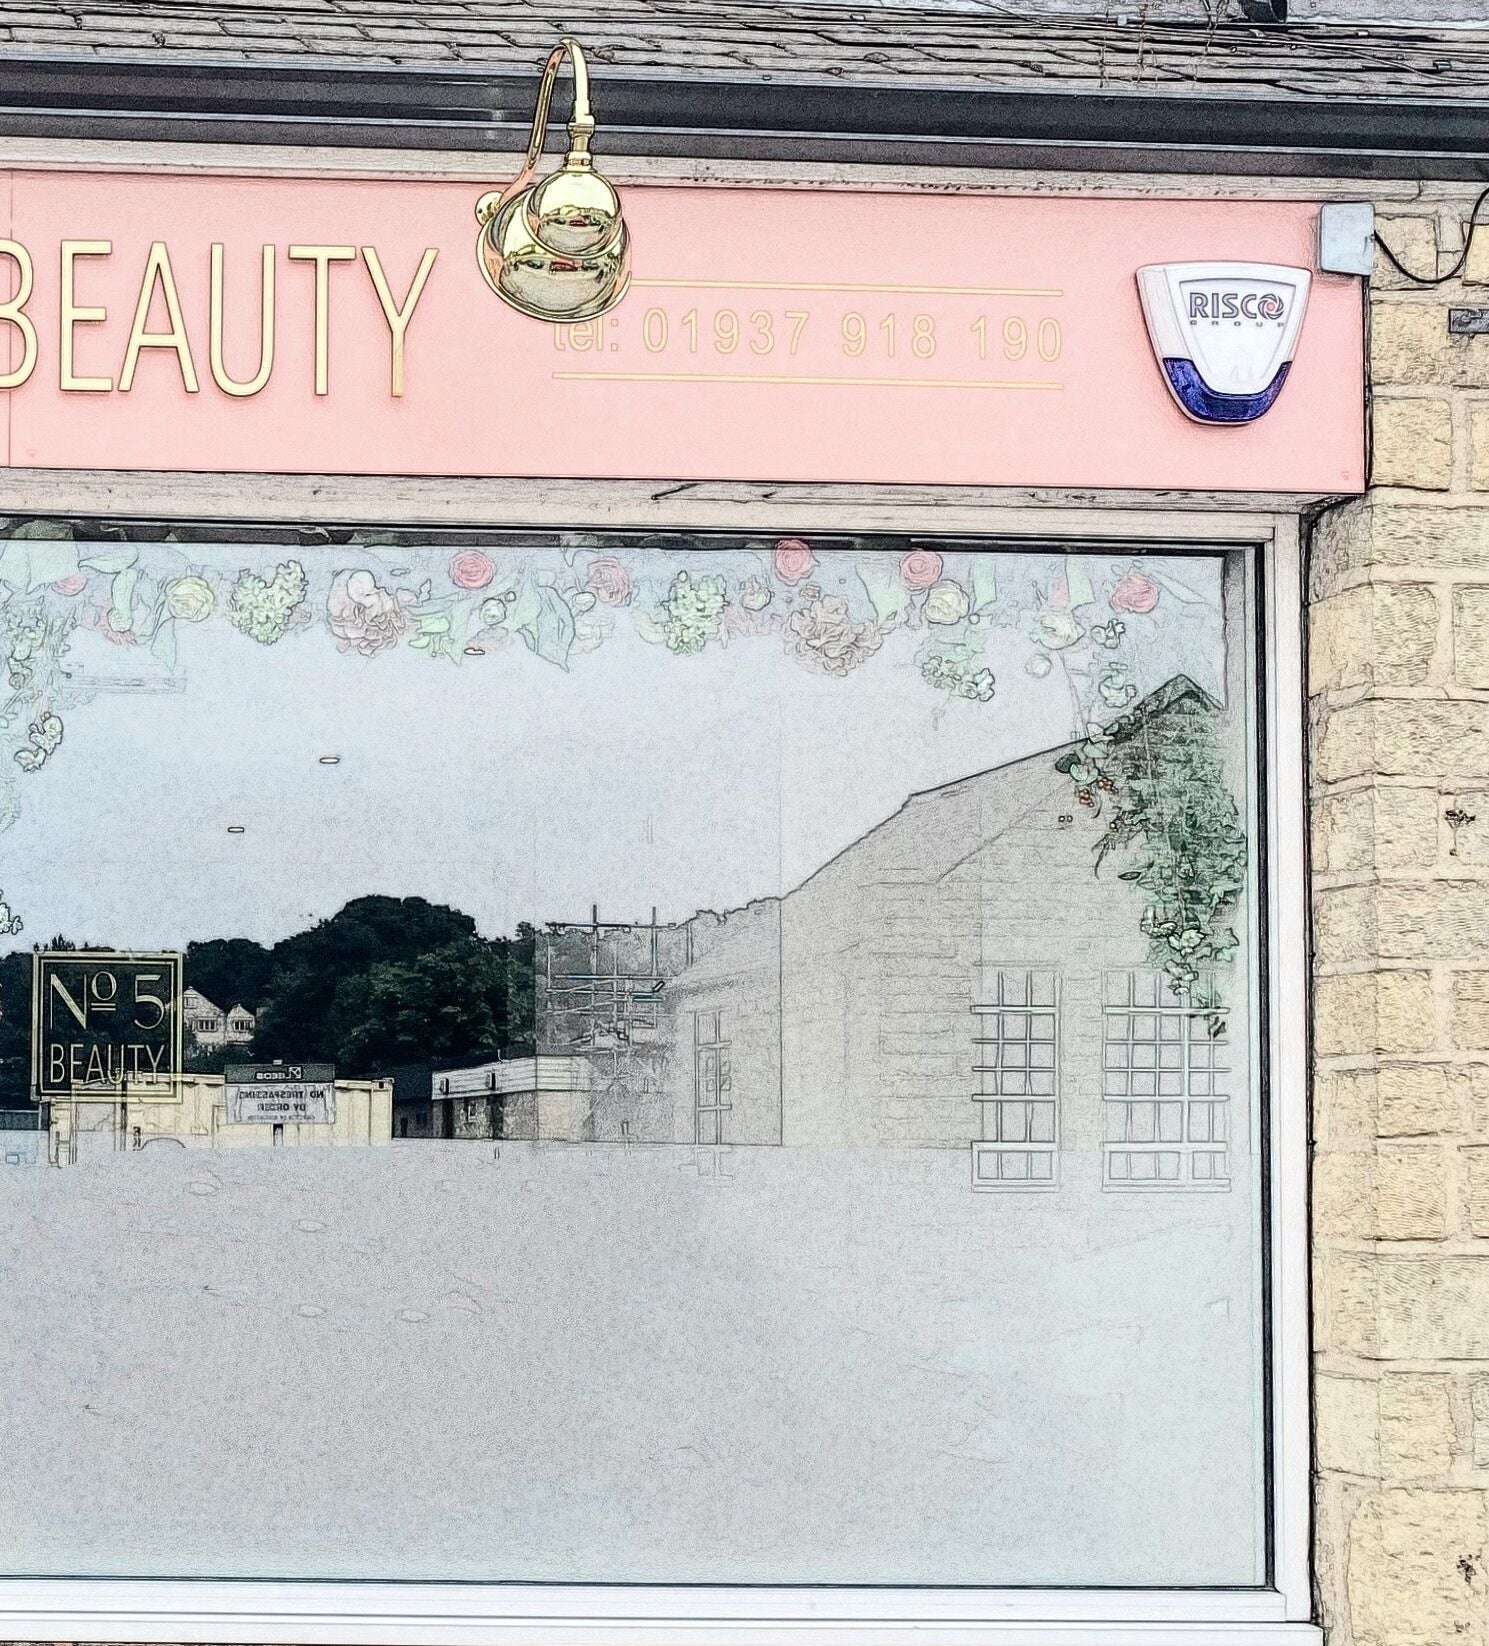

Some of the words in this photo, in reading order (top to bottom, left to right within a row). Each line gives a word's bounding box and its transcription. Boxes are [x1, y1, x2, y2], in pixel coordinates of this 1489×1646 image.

[1189, 292, 1284, 320] RISCO
[642, 307, 811, 357] 01937
[840, 311, 937, 359] 918
[970, 316, 1063, 363] 190
[1189, 320, 1284, 328] GROUP
[50, 1042, 165, 1085] BEAUTY
